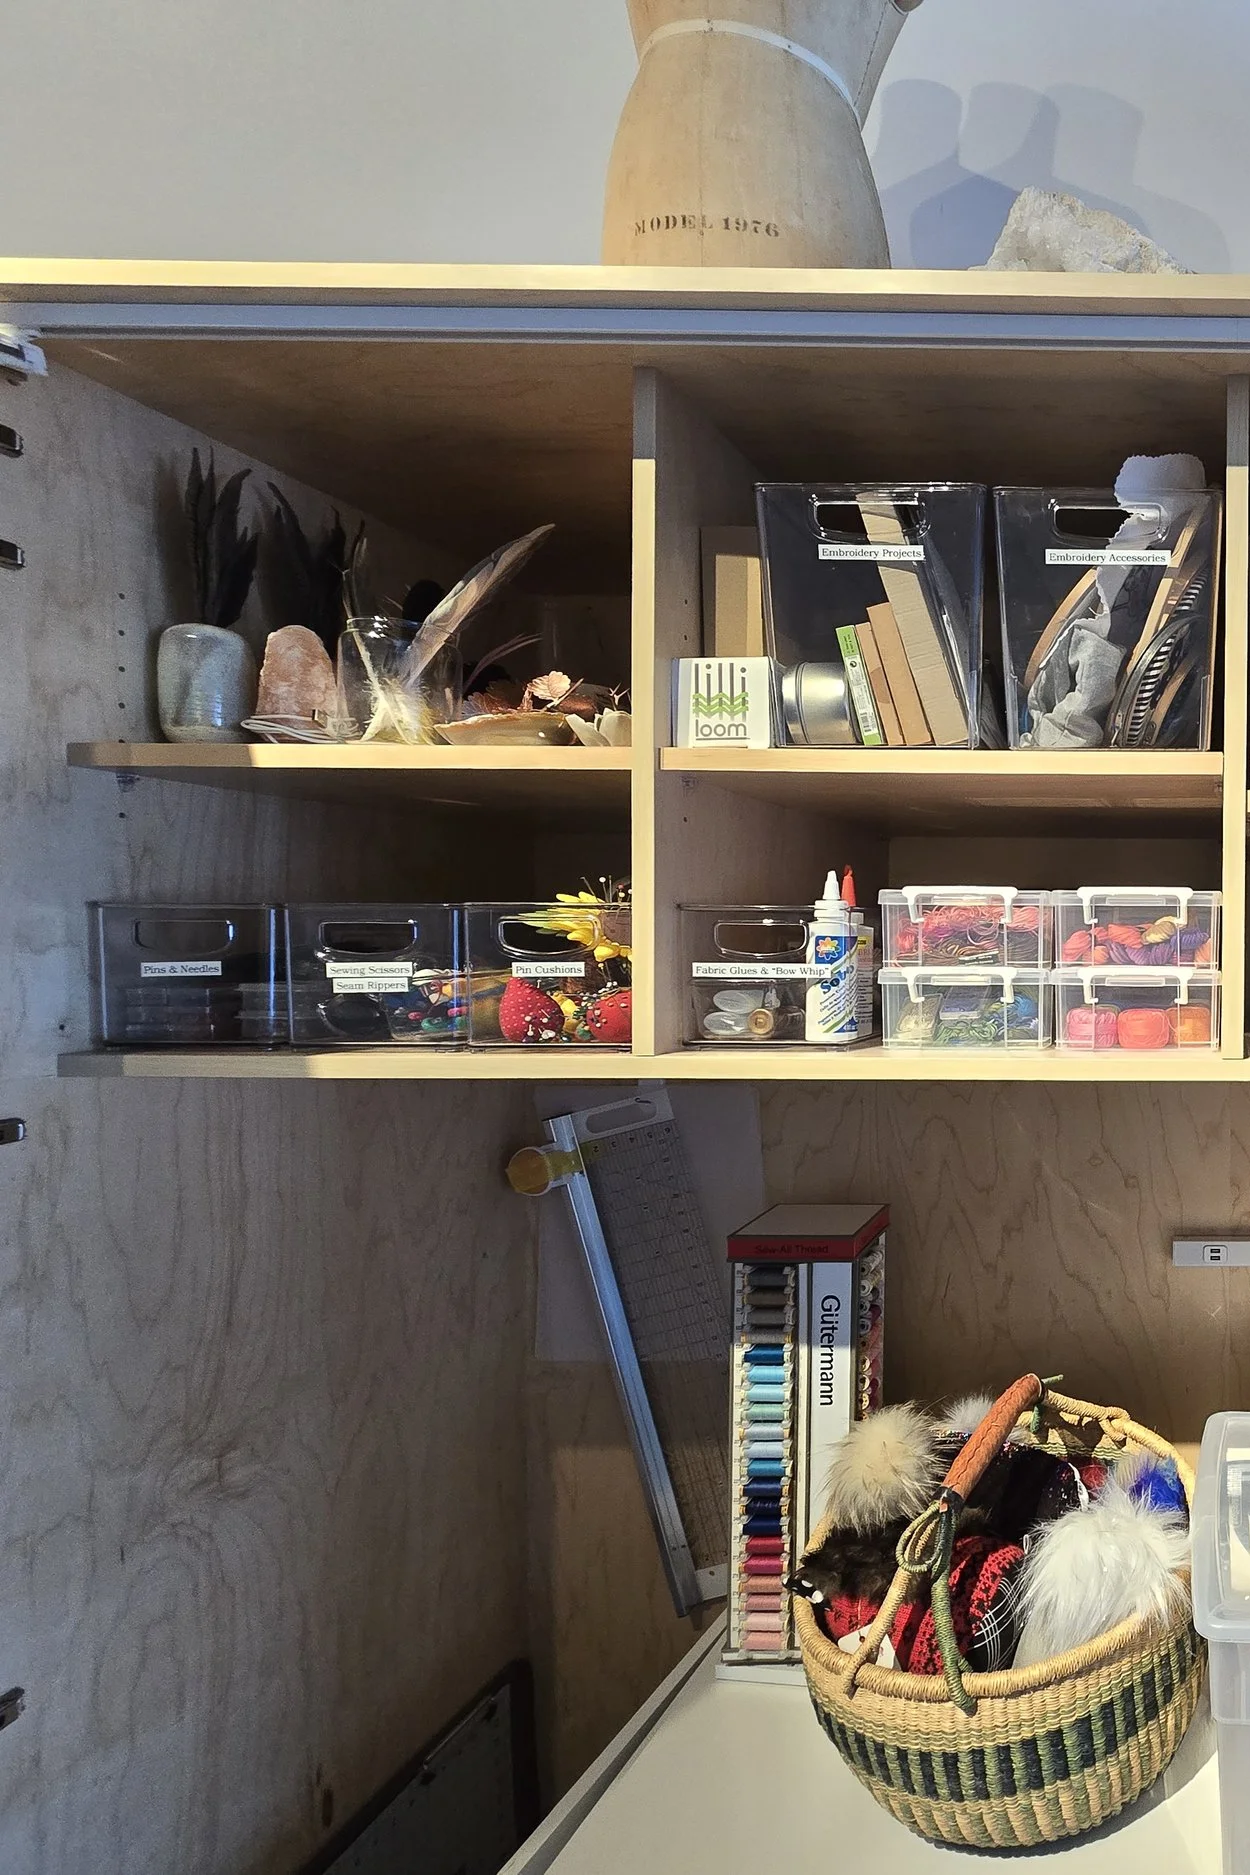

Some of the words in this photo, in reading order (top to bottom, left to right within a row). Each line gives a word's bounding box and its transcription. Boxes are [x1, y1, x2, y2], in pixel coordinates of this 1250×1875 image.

[634, 214, 713, 236] MODEL
[722, 216, 780, 237] 1976
[822, 548, 879, 559] Embroidery
[882, 548, 922, 560] Projects
[1049, 552, 1106, 563] Embroidery
[1109, 553, 1166, 563] Accessories
[695, 719, 747, 737] loom
[143, 965, 166, 974] Pins
[169, 965, 178, 973] &
[180, 965, 219, 973] Needles
[329, 966, 366, 976] Sewing
[368, 966, 410, 974] Scissors
[515, 965, 532, 974] Pin
[534, 965, 583, 974] Cushions
[695, 966, 727, 975] Fabric
[729, 966, 758, 975] Glues
[760, 966, 769, 975] &
[336, 981, 364, 990] Seam
[367, 981, 406, 991] Rippers
[795, 1244, 829, 1254] Thread
[820, 1294, 841, 1406] Gütermann
